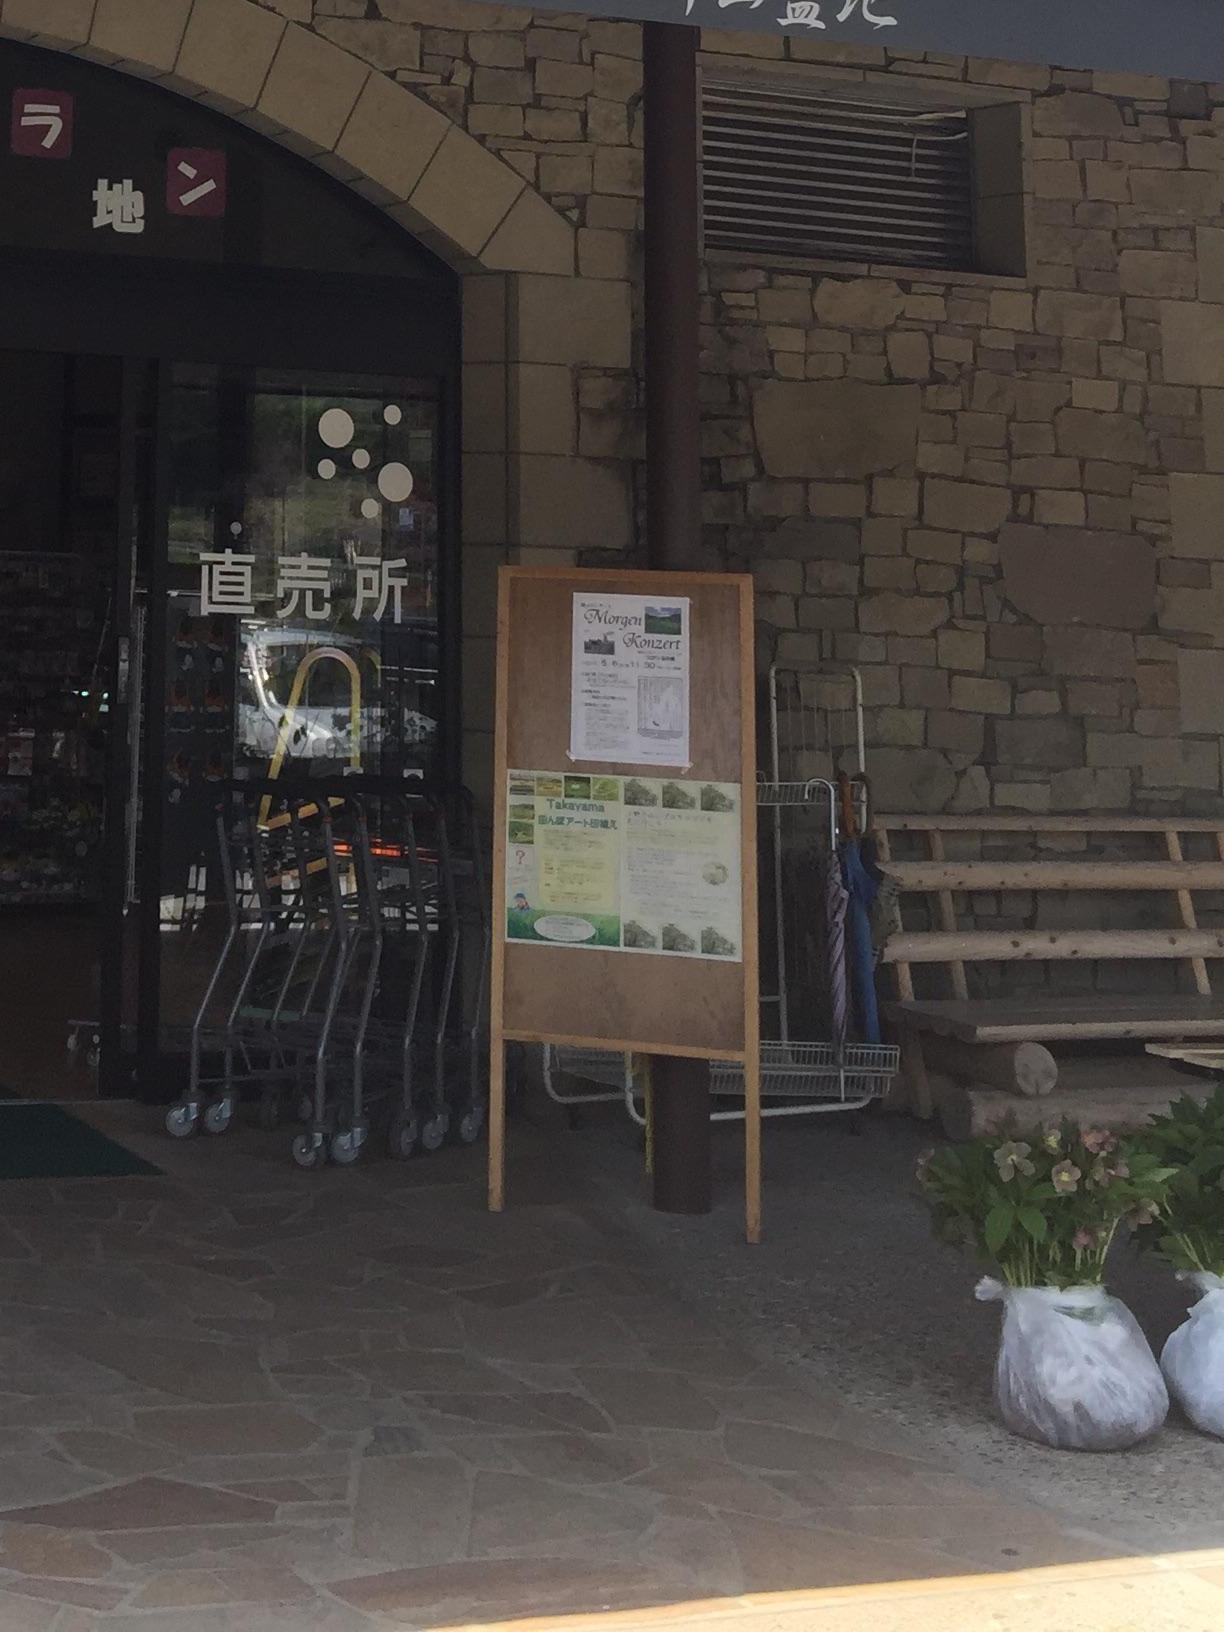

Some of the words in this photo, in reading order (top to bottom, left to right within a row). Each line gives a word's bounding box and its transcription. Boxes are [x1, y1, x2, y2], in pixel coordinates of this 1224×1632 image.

[199, 548, 408, 624] 直売所
[584, 608, 642, 630] Morgen
[623, 632, 682, 651] Konzert
[547, 799, 605, 813] Takayama
